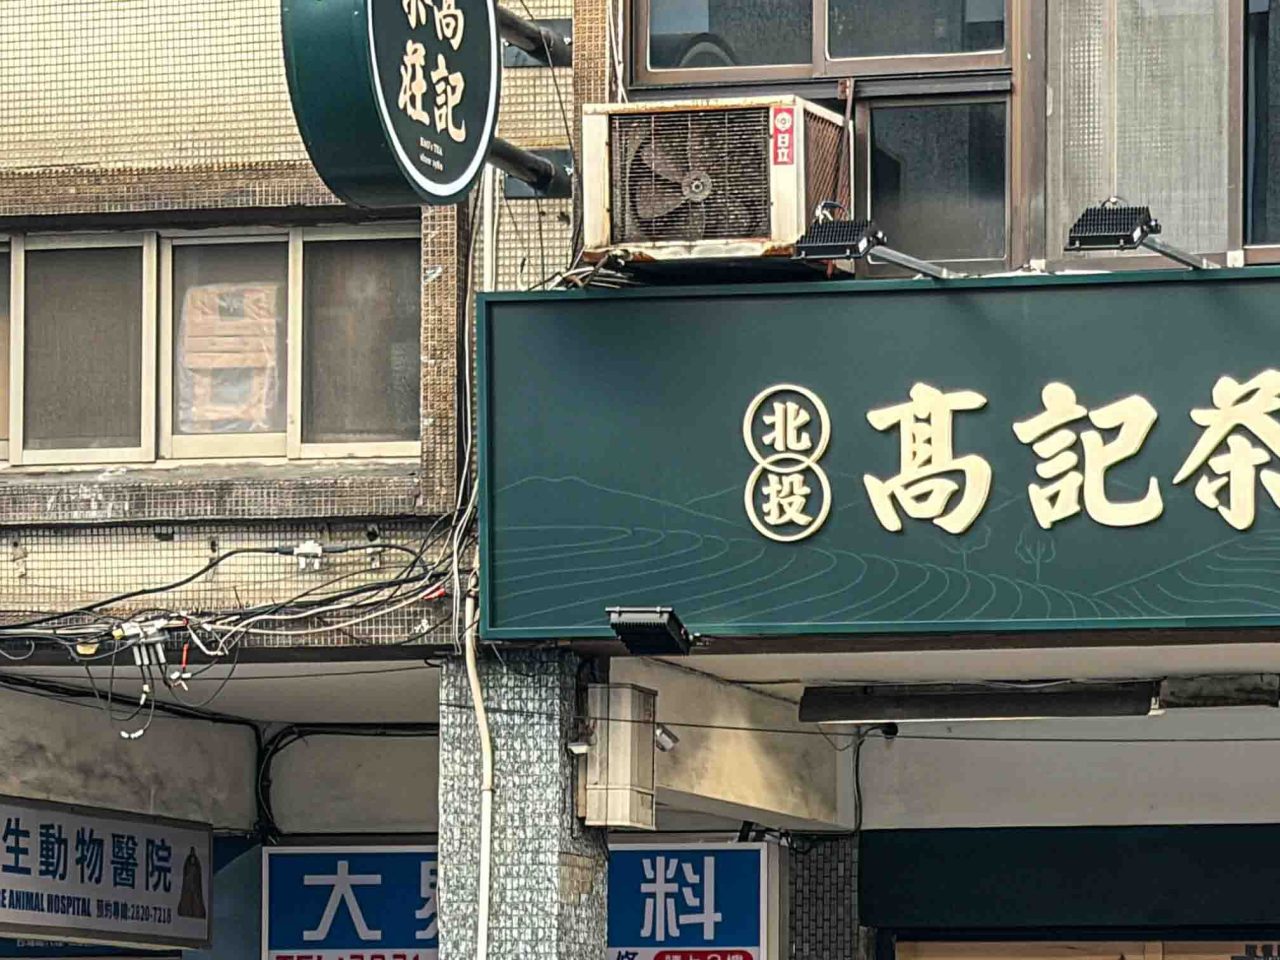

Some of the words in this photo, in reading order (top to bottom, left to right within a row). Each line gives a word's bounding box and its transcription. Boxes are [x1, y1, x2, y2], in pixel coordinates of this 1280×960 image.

[777, 133, 790, 162] 日立
[762, 402, 814, 526] 北投
[2, 817, 173, 893] 生動物醫院
[8, 889, 45, 913] ANIMAL
[47, 894, 92, 917] HOSPITAL
[640, 856, 723, 941] 料
